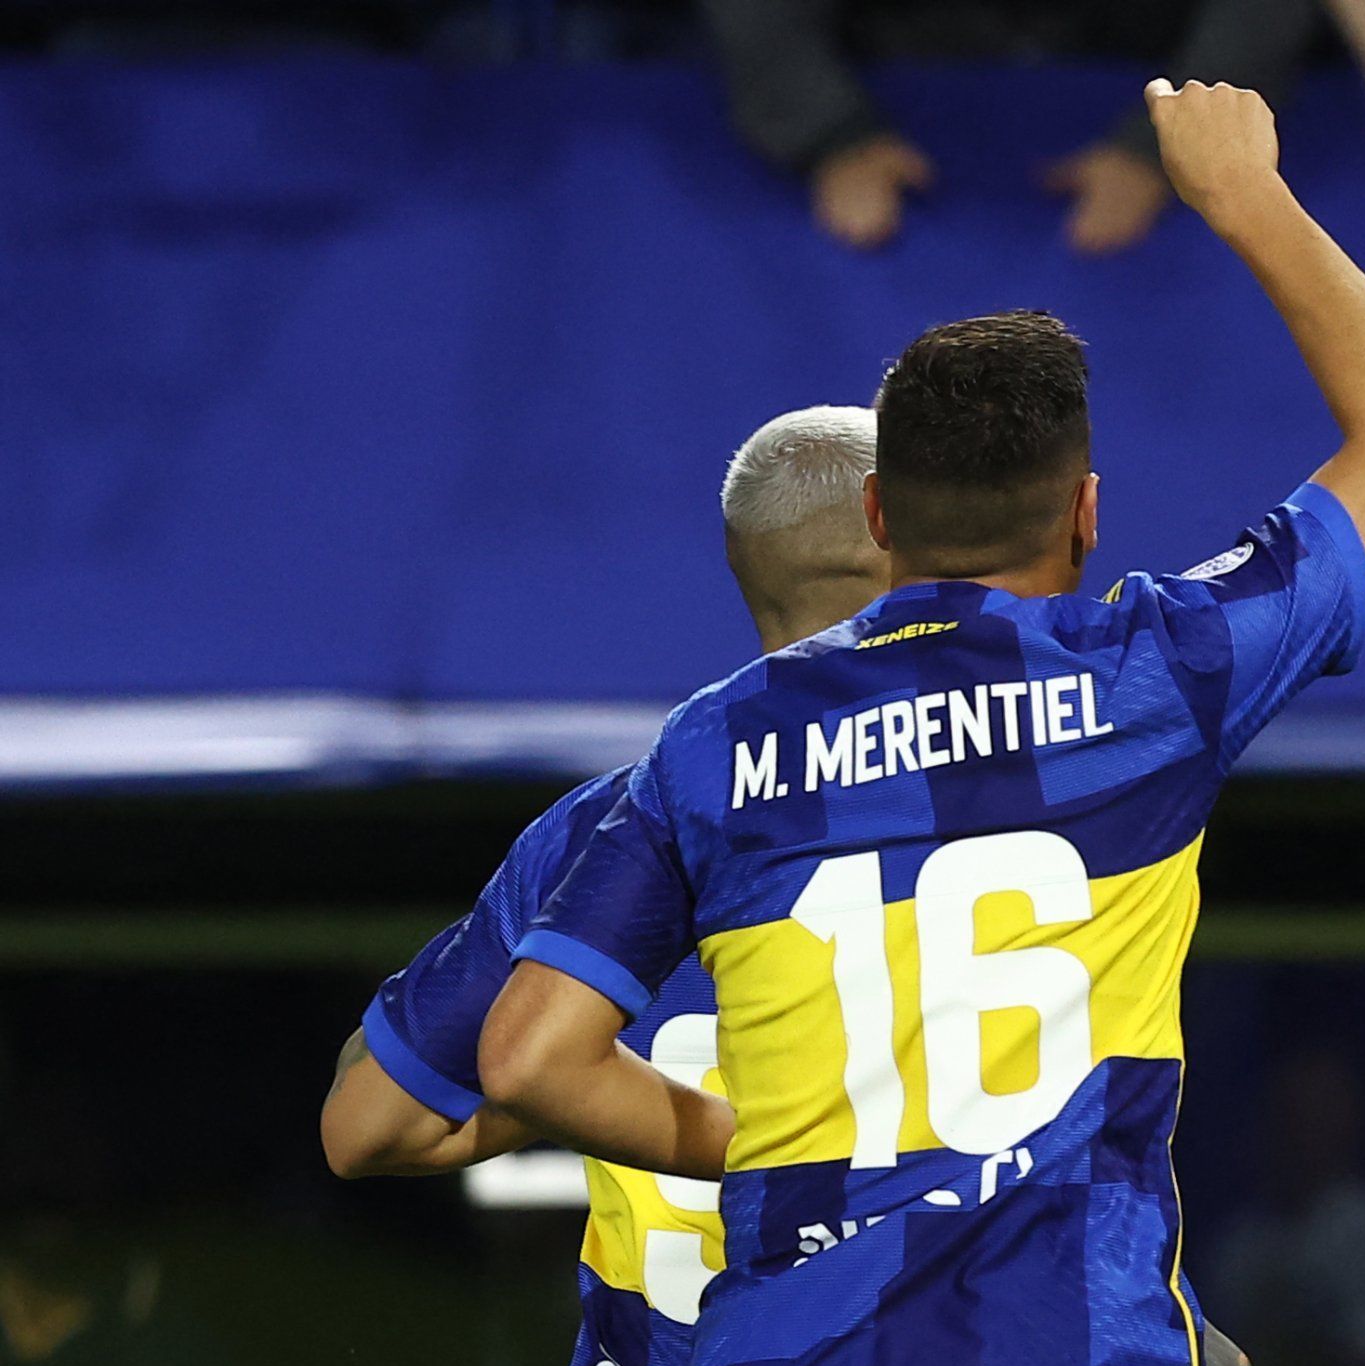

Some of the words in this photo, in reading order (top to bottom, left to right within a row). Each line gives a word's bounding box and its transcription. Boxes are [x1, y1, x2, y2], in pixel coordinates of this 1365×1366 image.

[732, 739, 789, 810] M.
[804, 672, 1114, 793] MERENTIEL
[788, 830, 1094, 1170] 16
